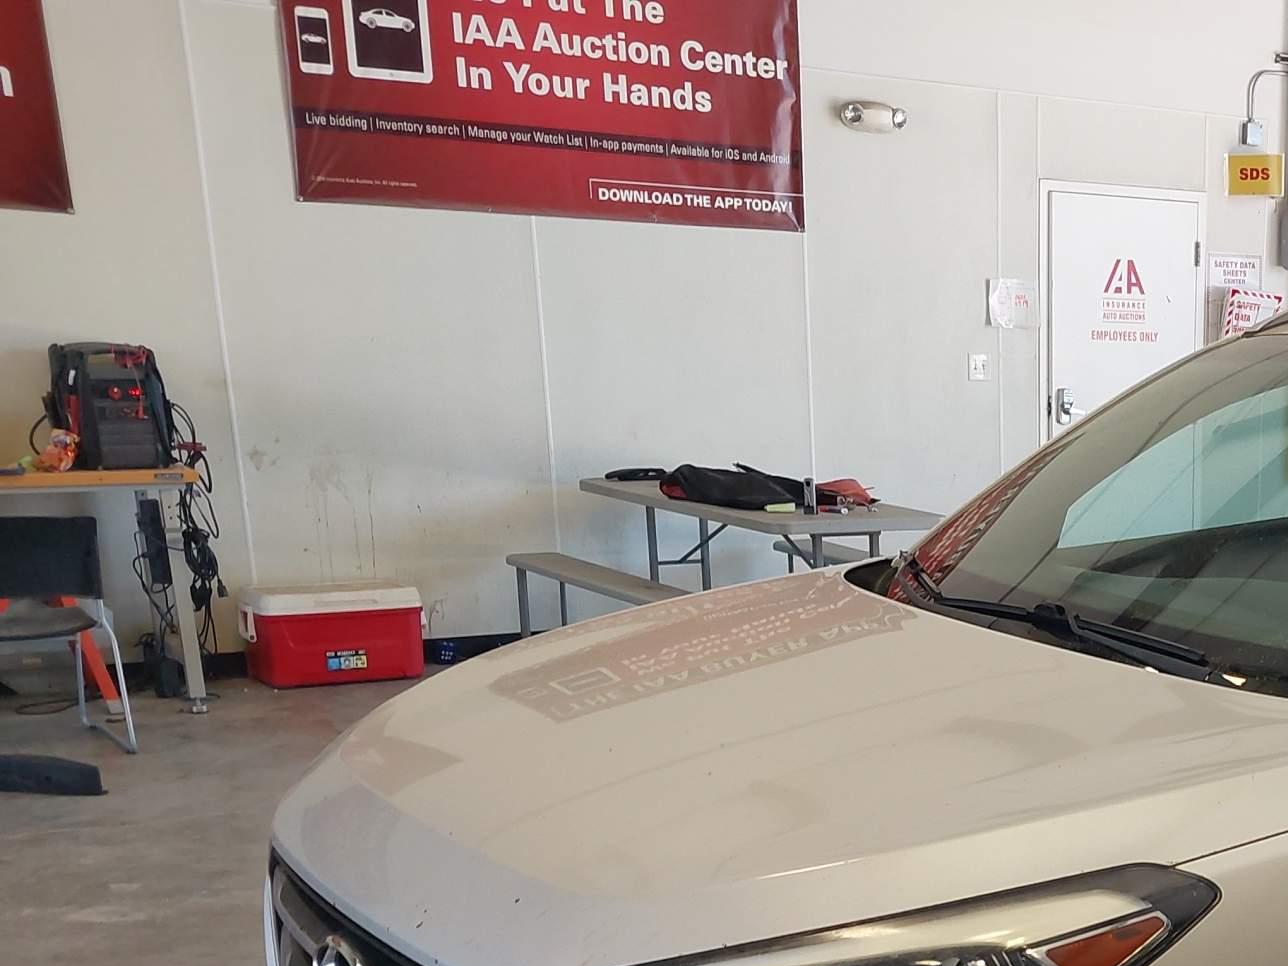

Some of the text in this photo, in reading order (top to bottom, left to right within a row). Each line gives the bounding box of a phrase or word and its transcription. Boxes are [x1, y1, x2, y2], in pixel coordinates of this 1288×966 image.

[603, 0, 665, 25] The
[451, 12, 788, 80] IAA Auction Center
[455, 57, 713, 113] In Your Hands
[305, 111, 327, 126] Live
[329, 113, 368, 131] bidding
[376, 117, 424, 136] Inventory
[425, 124, 460, 136] search
[468, 126, 508, 142] Manage
[510, 132, 532, 143] your
[532, 131, 565, 146] Watch
[566, 134, 584, 147] List
[590, 138, 620, 151] In-app
[621, 142, 664, 157] payments
[670, 143, 711, 159] Available
[711, 149, 724, 159] for
[725, 148, 741, 161] iOS
[742, 152, 758, 163] and
[1239, 167, 1270, 180] SDS
[598, 187, 793, 214] DOWNLOAD THE APP TODAY!
[1214, 260, 1256, 270] SAFETY DATA
[1222, 269, 1247, 277] SHEETS
[1103, 300, 1146, 310] INSURANCE
[1103, 311, 1146, 321] AUTO AUCTIONS
[1091, 329, 1159, 343] EMPLOYEES ONLY
